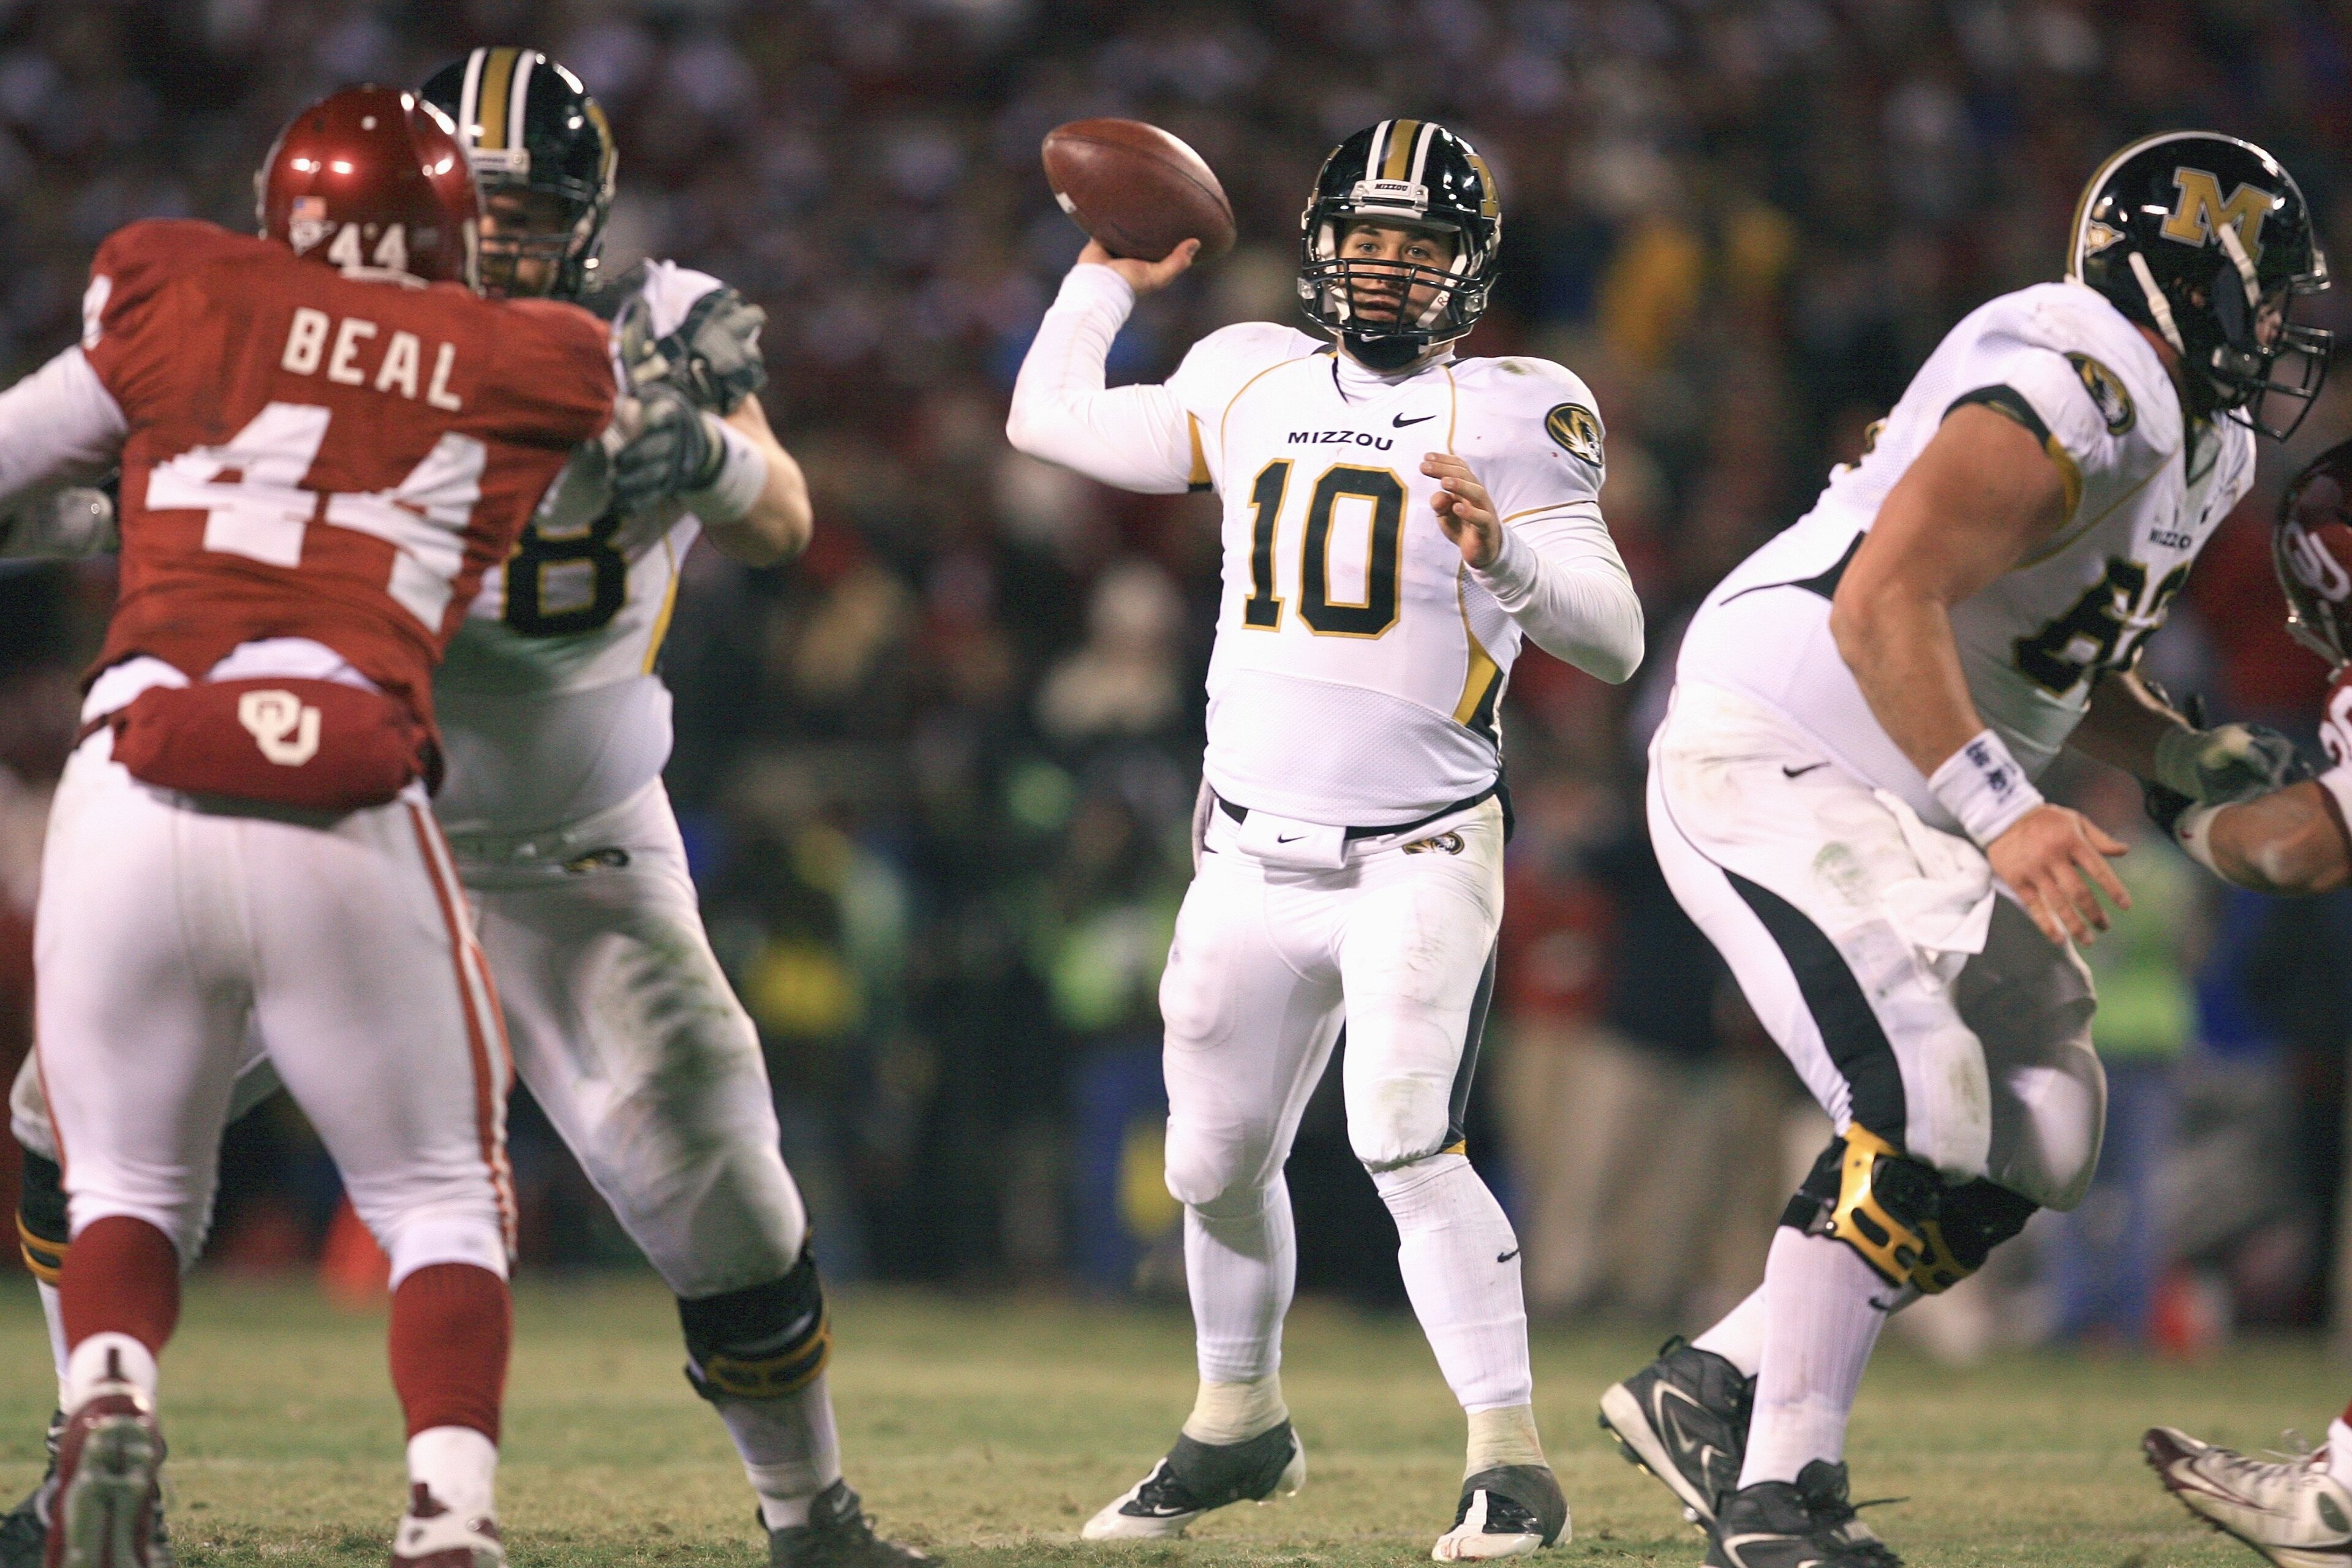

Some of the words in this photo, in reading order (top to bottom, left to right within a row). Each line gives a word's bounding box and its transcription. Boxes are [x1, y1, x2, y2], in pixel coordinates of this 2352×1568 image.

[1374, 183, 1408, 192] MIZZOU
[2160, 166, 2276, 265] M
[328, 221, 409, 270] 44
[282, 307, 462, 411] BEAL
[1287, 431, 1393, 451] MIZZOU
[146, 401, 486, 634] 44
[1243, 457, 1407, 639] 10
[2149, 528, 2192, 550] MIZZO
[238, 690, 321, 766] OU
